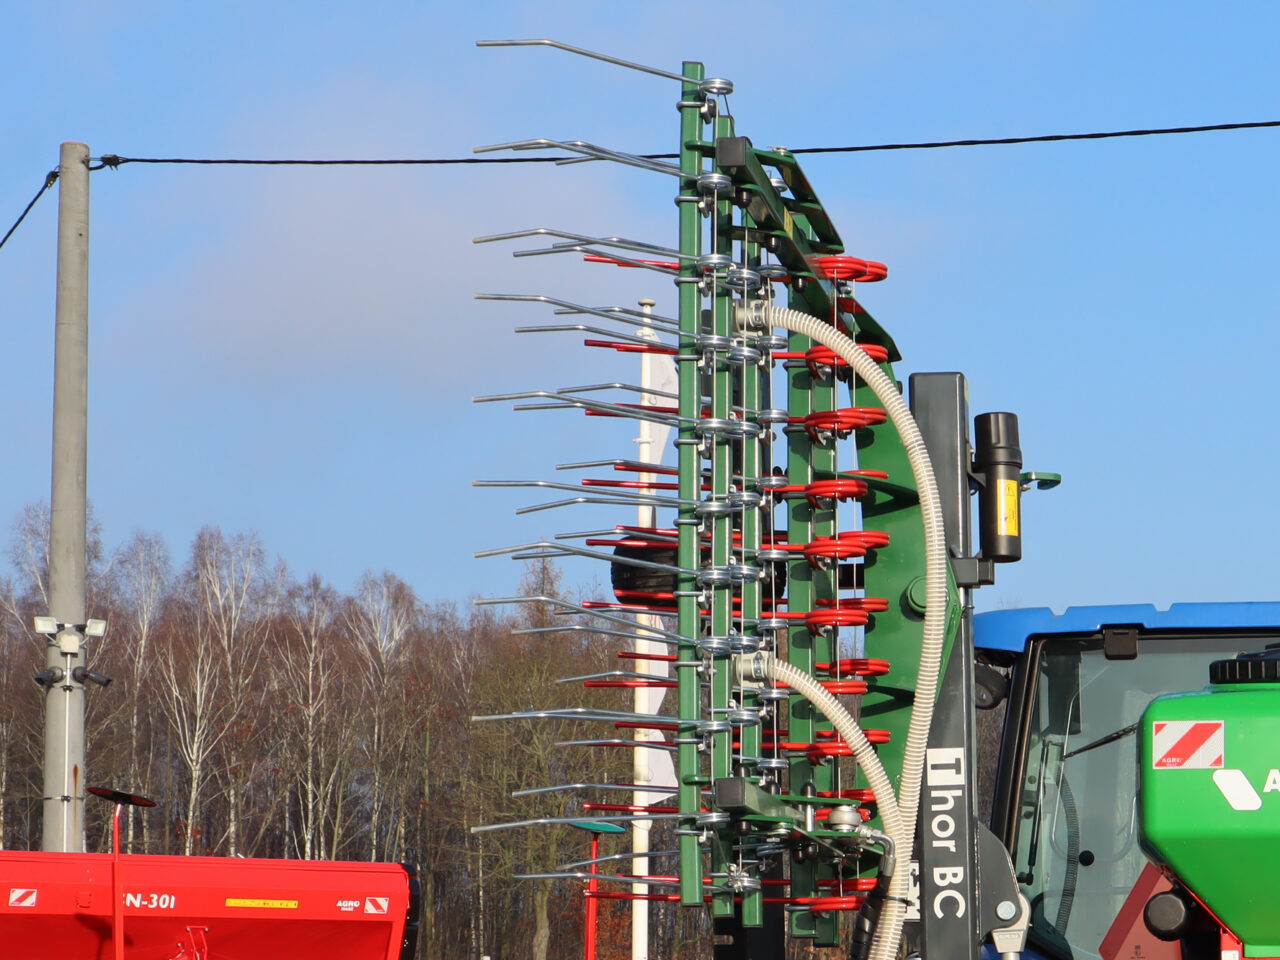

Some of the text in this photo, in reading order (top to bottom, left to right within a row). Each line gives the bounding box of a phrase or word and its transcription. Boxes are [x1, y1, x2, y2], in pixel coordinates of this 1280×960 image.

[926, 748, 965, 852] Thor
[336, 899, 361, 908] AGRO
[933, 866, 966, 919] BC
